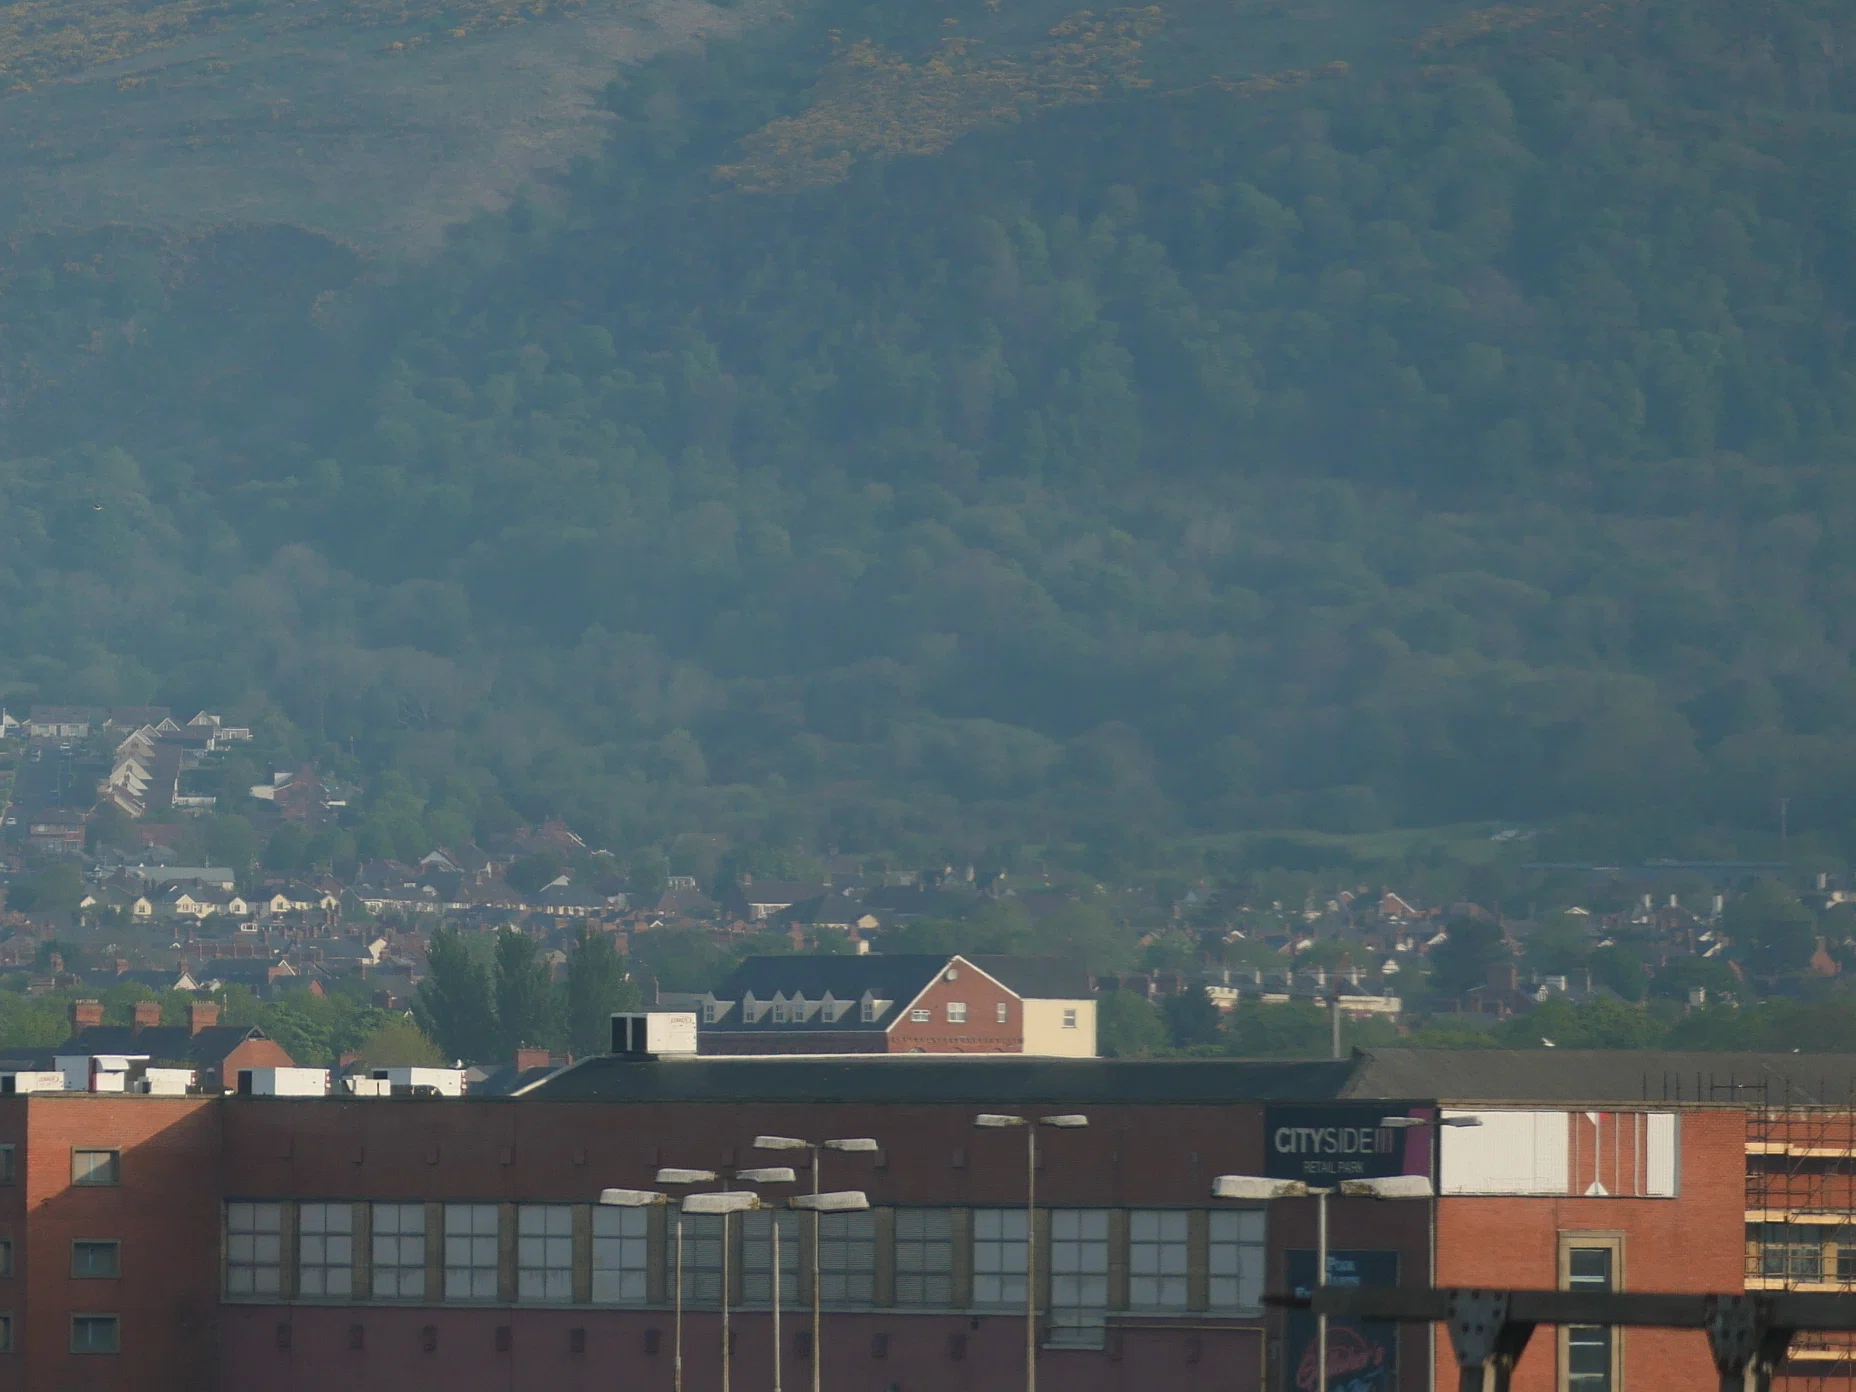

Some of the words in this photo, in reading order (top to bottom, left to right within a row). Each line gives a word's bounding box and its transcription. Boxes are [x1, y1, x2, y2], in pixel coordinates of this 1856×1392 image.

[1274, 1126, 1373, 1154] CITYSIDE
[1302, 1160, 1337, 1174] RETAIL
[1338, 1160, 1365, 1174] PARK
